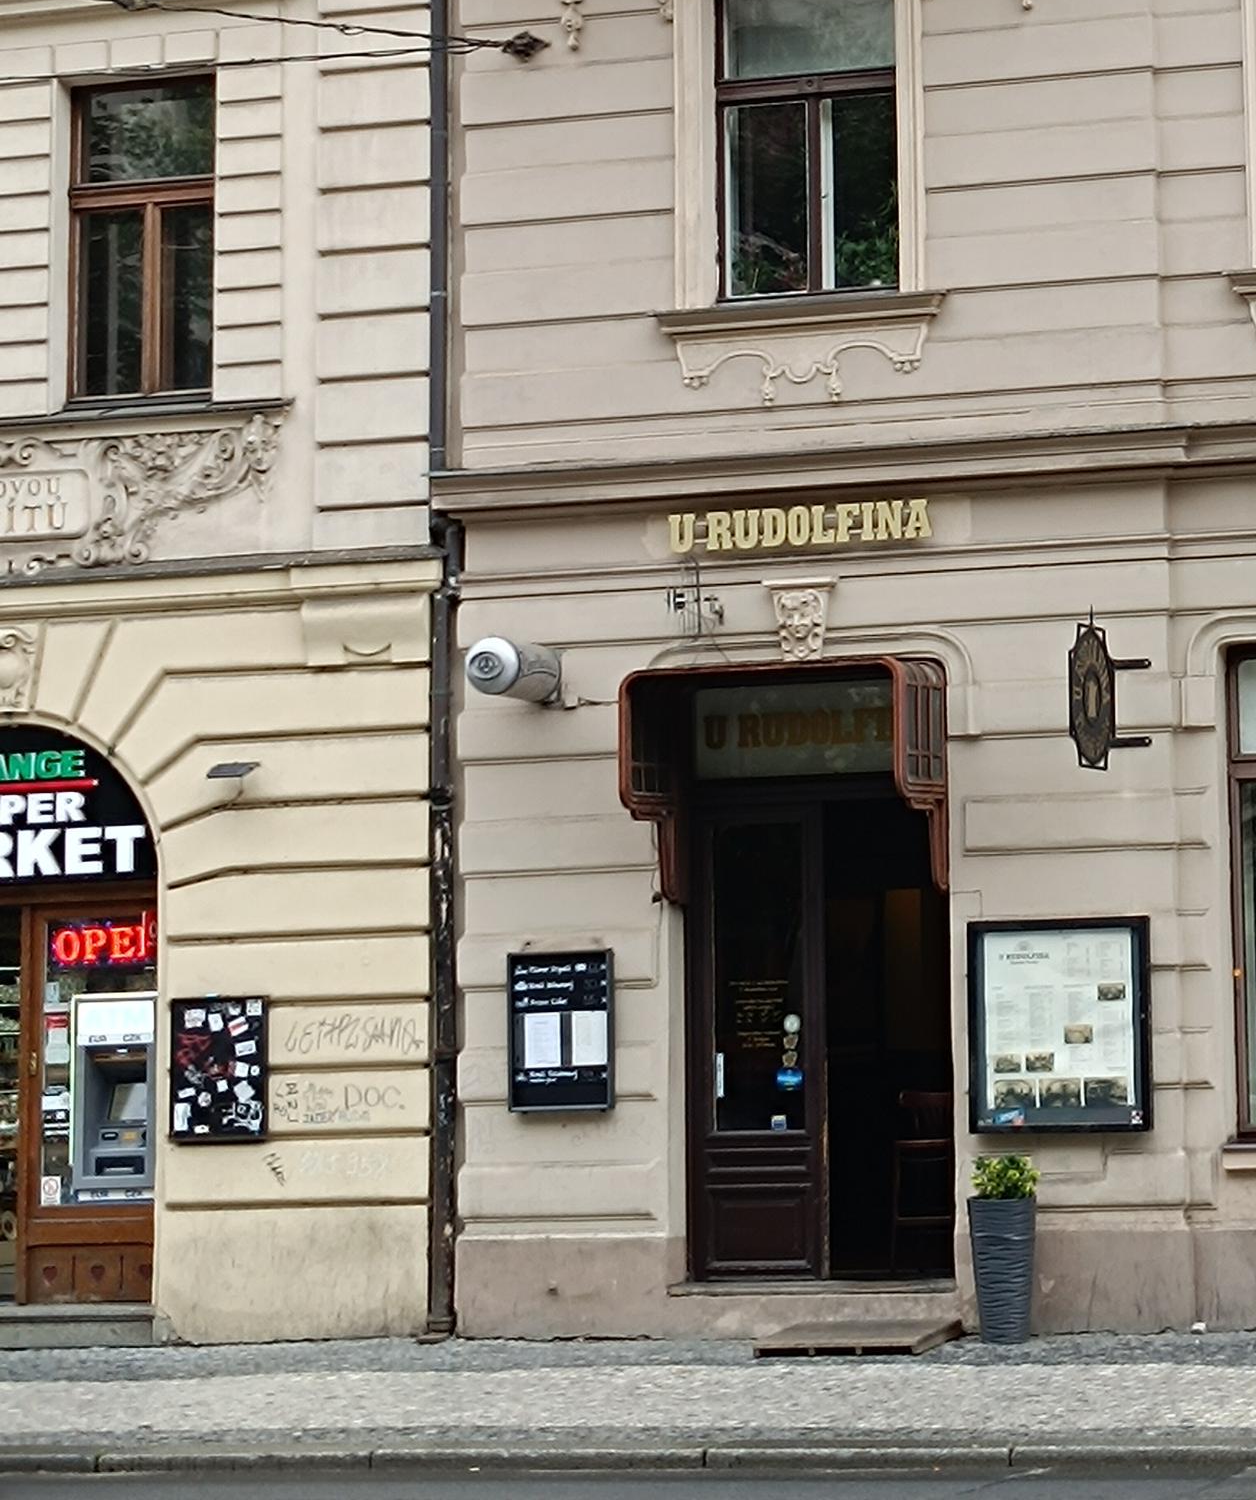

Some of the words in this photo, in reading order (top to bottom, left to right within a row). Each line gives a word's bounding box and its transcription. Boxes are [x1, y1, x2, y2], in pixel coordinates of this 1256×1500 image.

[668, 513, 696, 553] U
[706, 499, 932, 550] RUDOLFINA
[703, 714, 729, 750] U
[0, 792, 87, 825] PER
